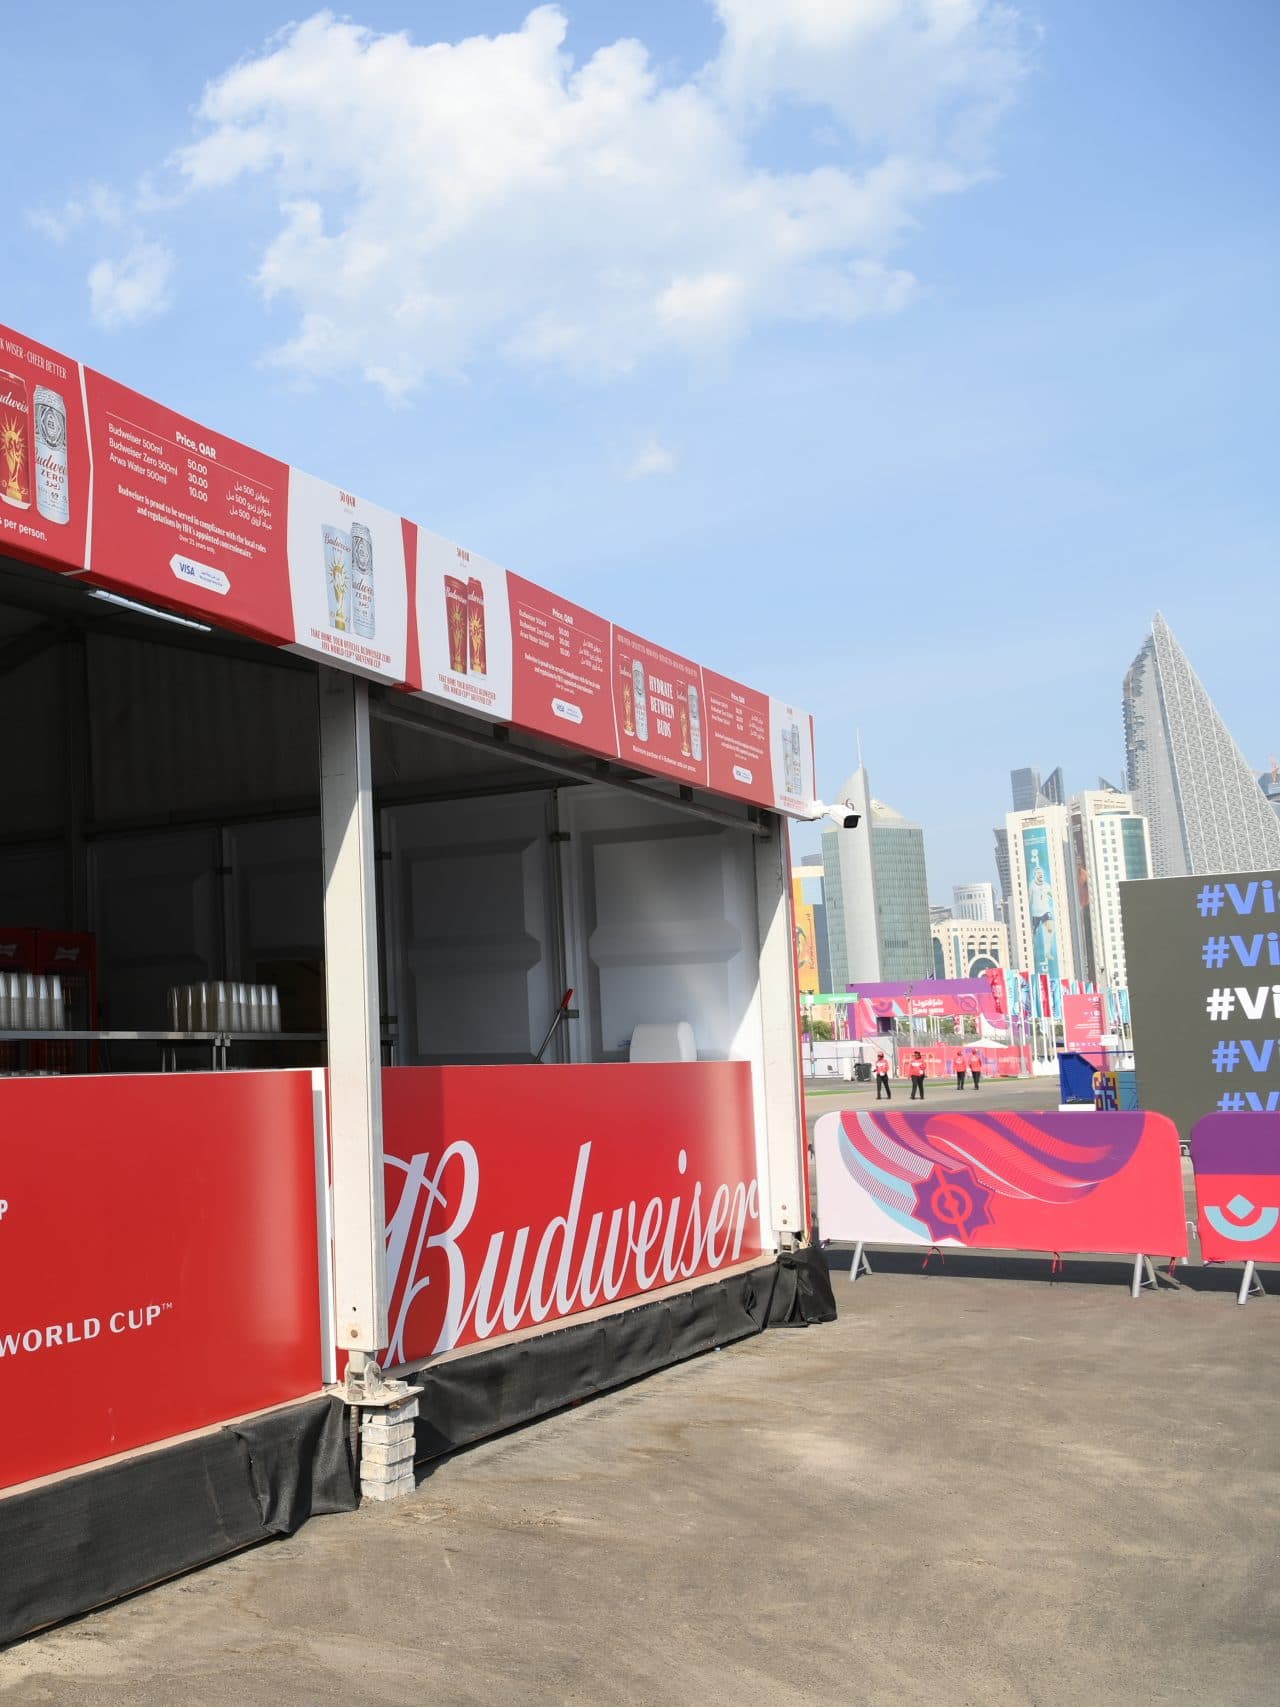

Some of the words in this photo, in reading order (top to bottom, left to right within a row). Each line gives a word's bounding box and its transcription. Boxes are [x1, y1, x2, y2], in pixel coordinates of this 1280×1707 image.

[5, 340, 24, 360] WISER
[27, 350, 45, 370] CHEER
[45, 359, 67, 380] BETTER
[109, 423, 141, 444] Budweiser
[142, 439, 163, 455] 500ml
[176, 431, 198, 452] Price,
[199, 443, 216, 460] QAR
[109, 437, 141, 459] Budweiser
[142, 452, 157, 467] Zero
[158, 460, 178, 476] 500ml
[109, 452, 126, 467] Arwa
[127, 459, 145, 475] Water
[146, 469, 167, 485] 500ml
[187, 459, 208, 475] 50.00
[41, 470, 64, 484] ZERO
[187, 472, 208, 489] 30.00
[188, 486, 208, 502] 10.00
[4, 518, 17, 532] per
[19, 523, 48, 542] person.
[179, 562, 195, 577] VISA
[649, 674, 673, 699] HYDRATE
[650, 695, 674, 719] BETWEEN
[657, 718, 671, 738] BUDS
[1196, 880, 1280, 917] #Vi
[1212, 1039, 1280, 1073] #V
[376, 1140, 760, 1369] Budweiser
